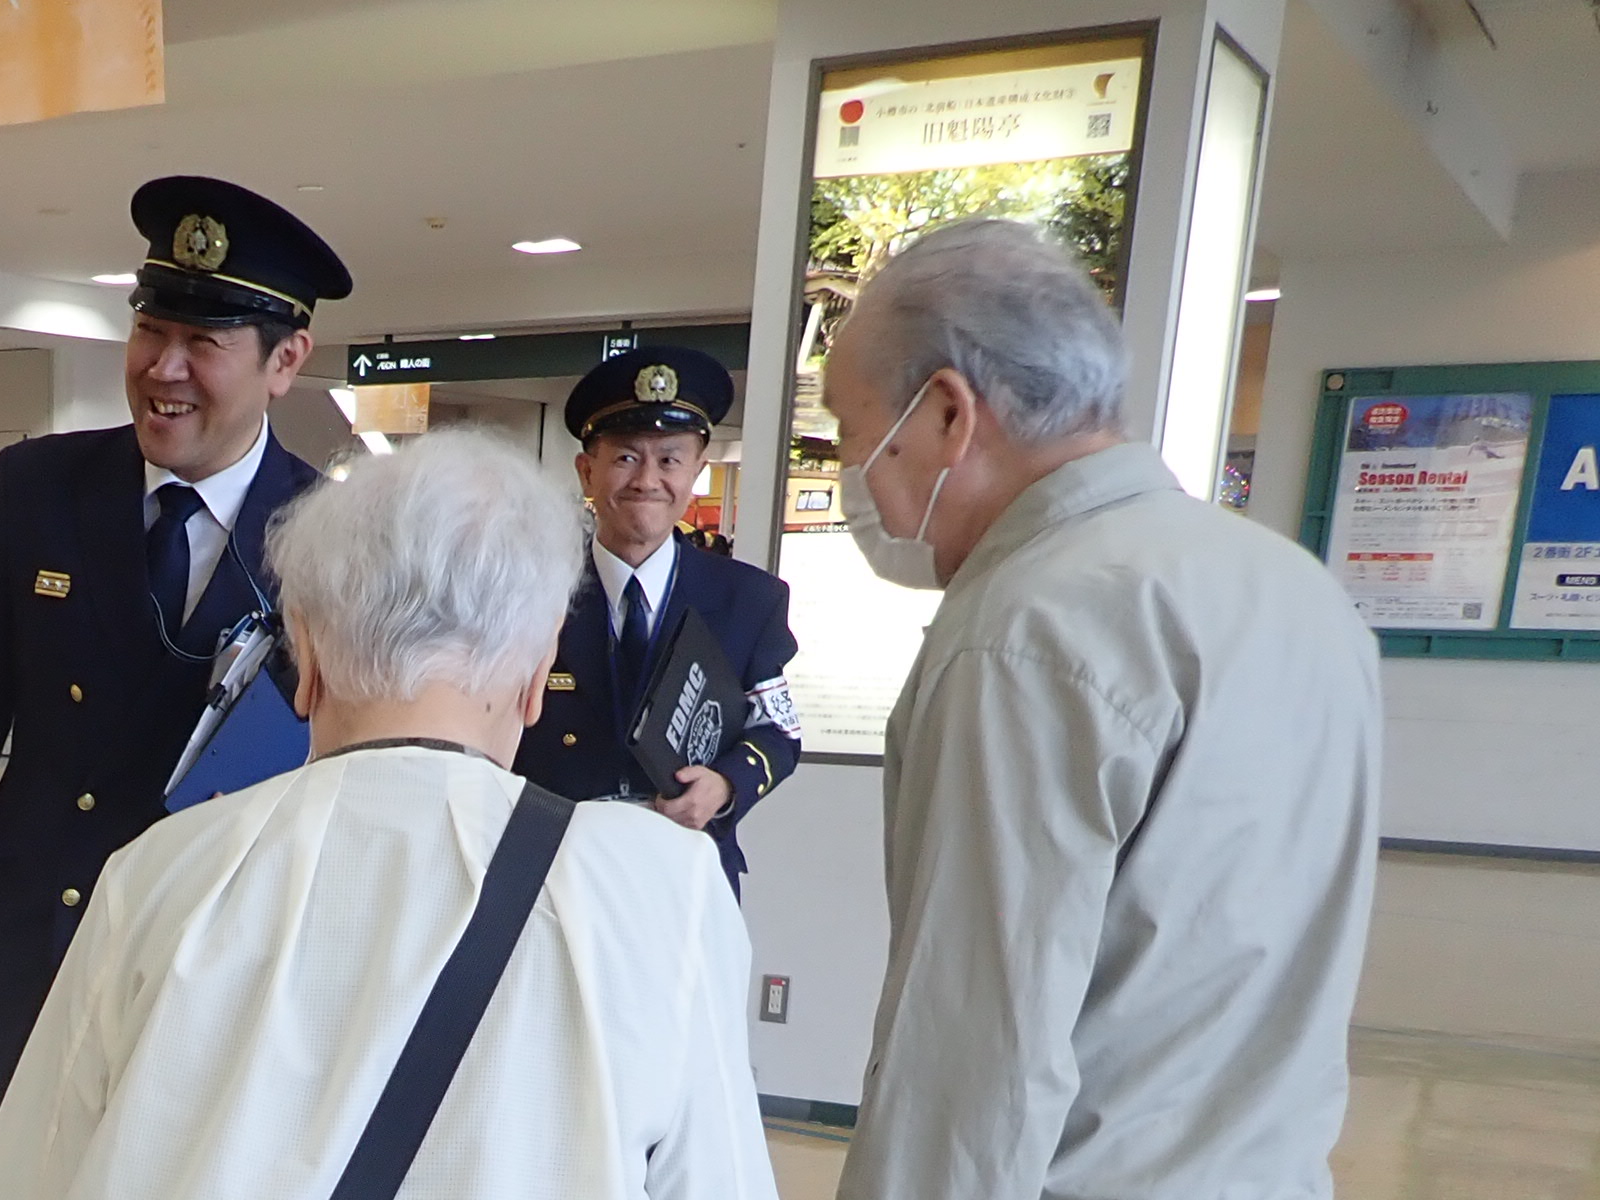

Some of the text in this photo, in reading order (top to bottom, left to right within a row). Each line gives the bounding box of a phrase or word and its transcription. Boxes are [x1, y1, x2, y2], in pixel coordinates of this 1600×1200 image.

[1358, 469, 1468, 486] Season Rental
[665, 661, 704, 752] FDMC
